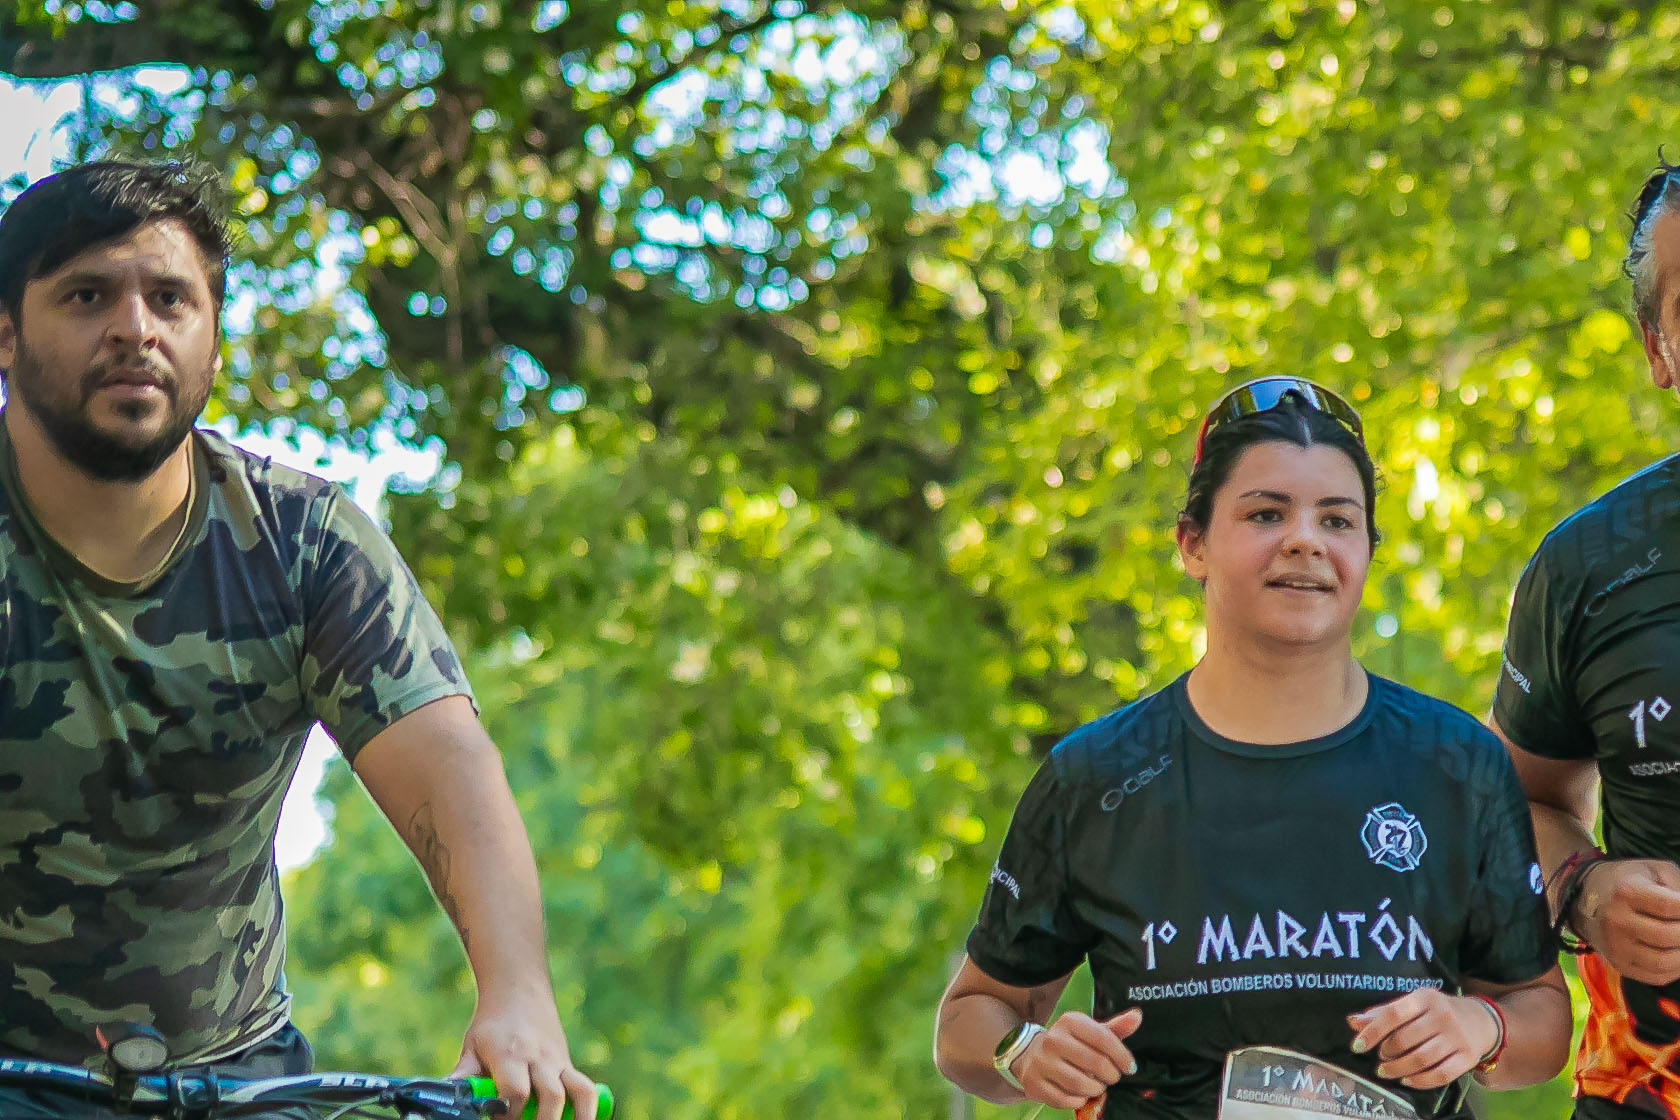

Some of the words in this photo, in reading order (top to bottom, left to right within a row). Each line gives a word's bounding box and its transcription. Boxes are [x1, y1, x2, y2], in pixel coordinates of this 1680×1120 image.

[1197, 897, 1434, 965] MARATÓN
[1128, 978, 1208, 1001] ASOCIACIÓN
[1211, 973, 1293, 994] BOMBEROS
[1295, 973, 1394, 992] VOLUNTARIOS
